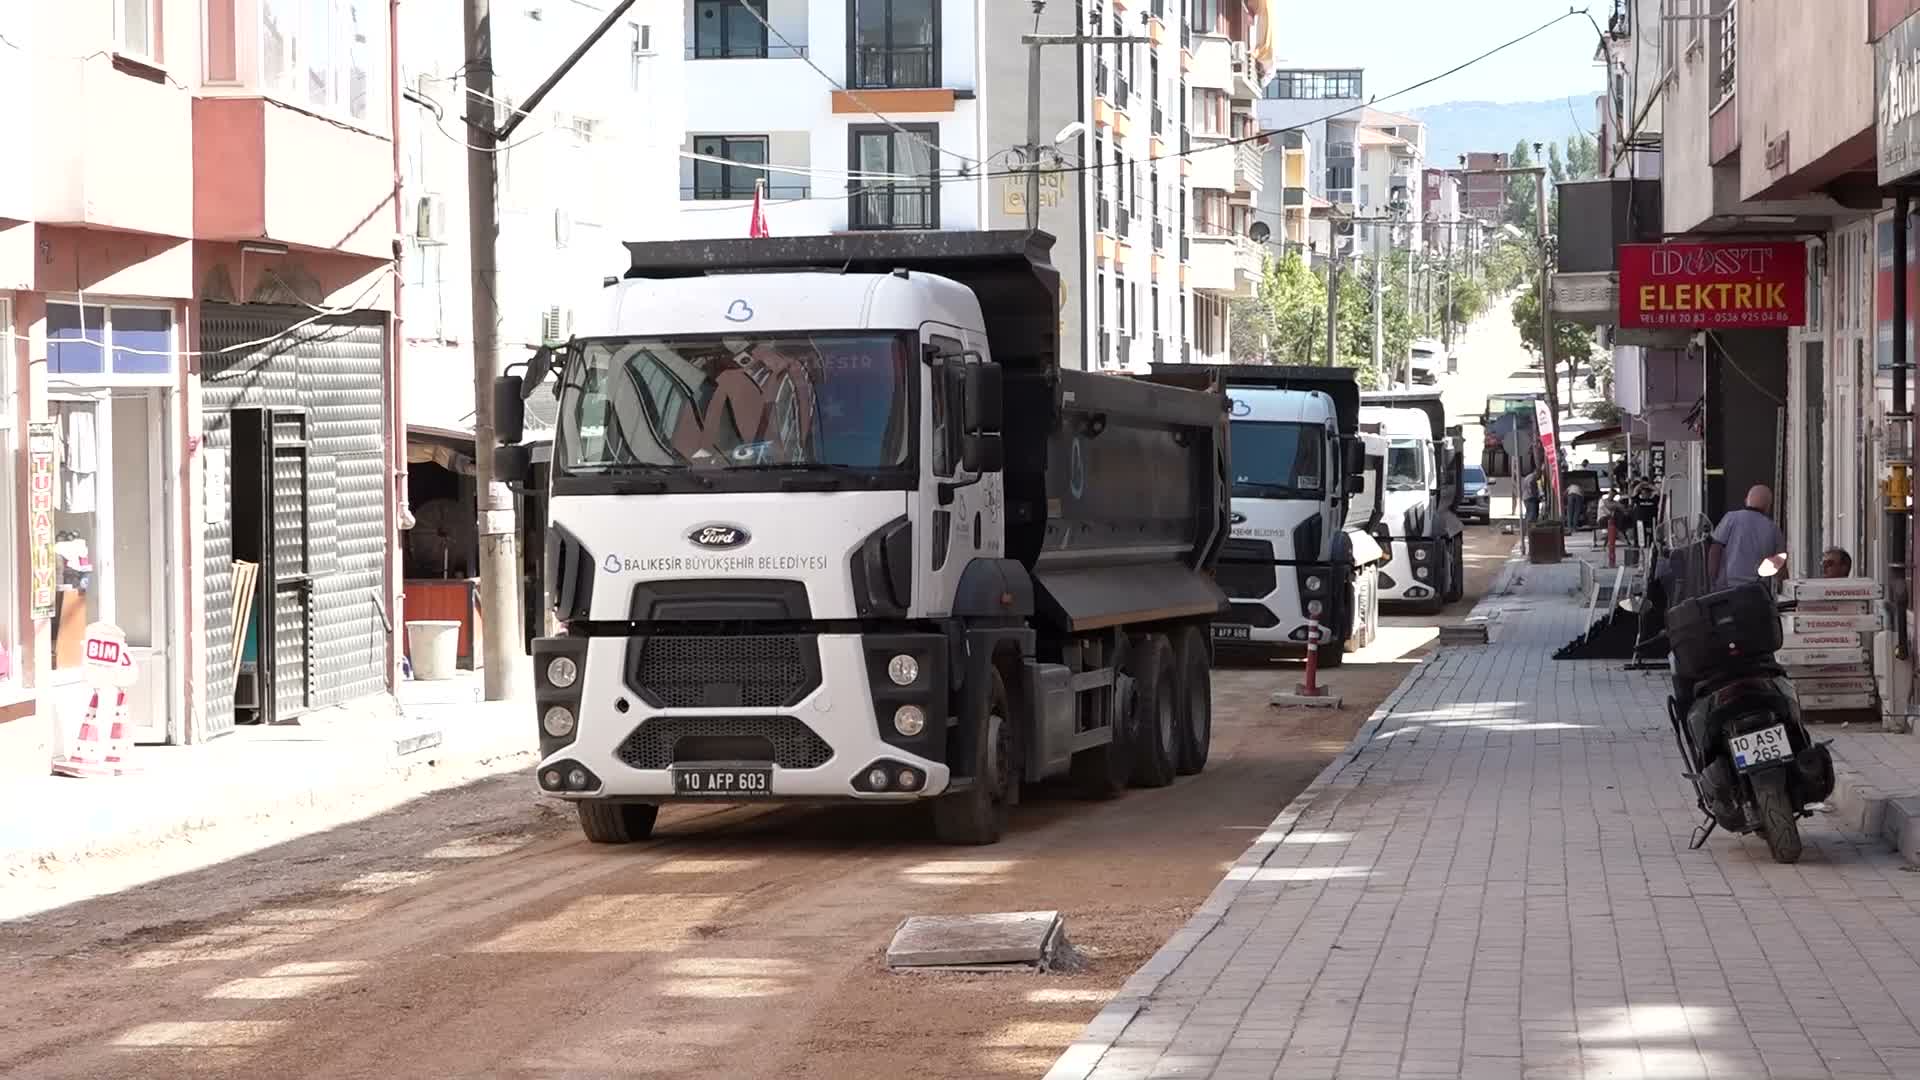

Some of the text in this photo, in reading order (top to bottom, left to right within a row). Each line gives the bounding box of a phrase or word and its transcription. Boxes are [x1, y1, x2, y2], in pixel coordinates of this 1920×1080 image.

[1639, 276, 1786, 311] ELEKTRİK
[699, 527, 736, 545] Ford
[624, 556, 828, 573] BALIKESİR BÜYÜKŞEHİR BELEDİYESİ
[1734, 728, 1783, 752] 10 ASY
[1752, 745, 1781, 762] 265
[684, 773, 765, 789] 10 AFP 603
